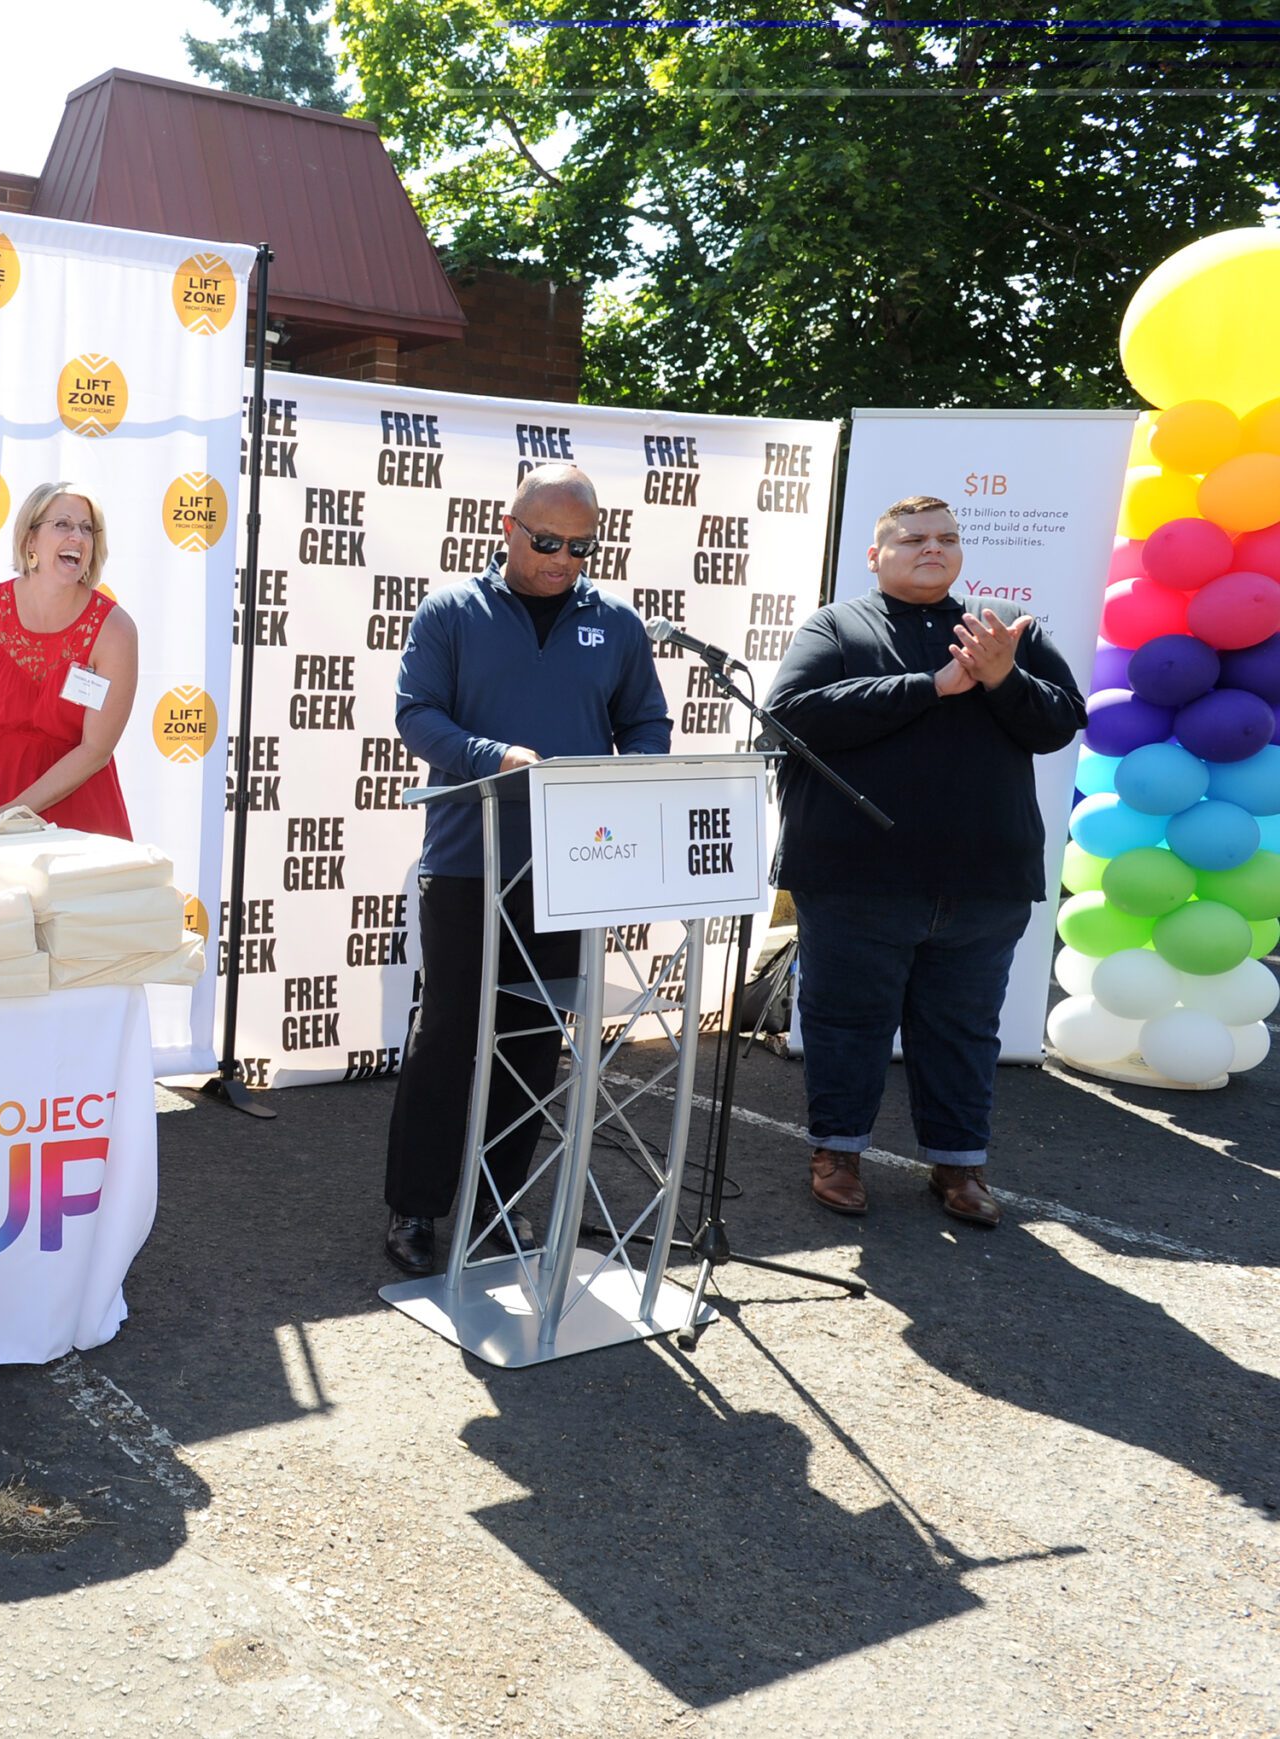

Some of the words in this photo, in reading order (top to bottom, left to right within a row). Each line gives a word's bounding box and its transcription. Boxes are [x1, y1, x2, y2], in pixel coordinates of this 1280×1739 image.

[183, 290, 226, 306] ZONE
[188, 277, 222, 292] LIFT
[68, 390, 116, 407] ZONE
[76, 378, 112, 392] LIFT
[88, 406, 112, 415] COMCAST
[380, 410, 442, 449] FREE
[516, 424, 574, 460] FREE
[377, 449, 444, 489] GEEK
[644, 434, 700, 470] FREE
[764, 442, 813, 478] FREE
[644, 470, 700, 507] GEEK
[756, 478, 810, 514] GEEK
[964, 472, 1008, 496] $1B
[172, 508, 216, 522] ZONE
[179, 496, 213, 509] LIFT
[305, 487, 366, 527] FREE
[446, 497, 506, 535] FREE
[961, 507, 972, 517] $1
[974, 508, 1006, 517] billion
[1010, 509, 1020, 518] to
[1022, 508, 1068, 518] advance
[597, 508, 634, 543] REE
[697, 514, 749, 550] FREE
[970, 522, 991, 532] and
[994, 522, 1020, 532] build
[1032, 523, 1066, 532] future
[982, 536, 1045, 546] Possibilities.
[299, 527, 366, 567] GEEK
[582, 547, 632, 581] EEK
[693, 551, 750, 586] GEEK
[372, 575, 430, 612] FREE
[632, 588, 686, 622] FREE
[964, 580, 1032, 602] Years
[749, 592, 796, 626] FREE
[578, 630, 605, 648] UP
[744, 628, 794, 662] GEEK
[294, 654, 356, 691] FREE
[686, 666, 736, 699] FR
[163, 721, 207, 734] ZONE
[169, 708, 203, 722] LIFT
[288, 694, 356, 730] GEEK
[681, 702, 734, 735] GEEK
[287, 816, 345, 852] FREE
[688, 808, 731, 841] FREE
[569, 843, 638, 862] COMCAST
[688, 842, 734, 876] GEEK
[282, 856, 346, 892] GEEK
[350, 894, 407, 930] FREE
[346, 931, 408, 968] GEEK
[284, 974, 338, 1013] FREE
[282, 1013, 340, 1052] GEEK
[234, 1058, 271, 1088] REE
[343, 1047, 400, 1080] FREE
